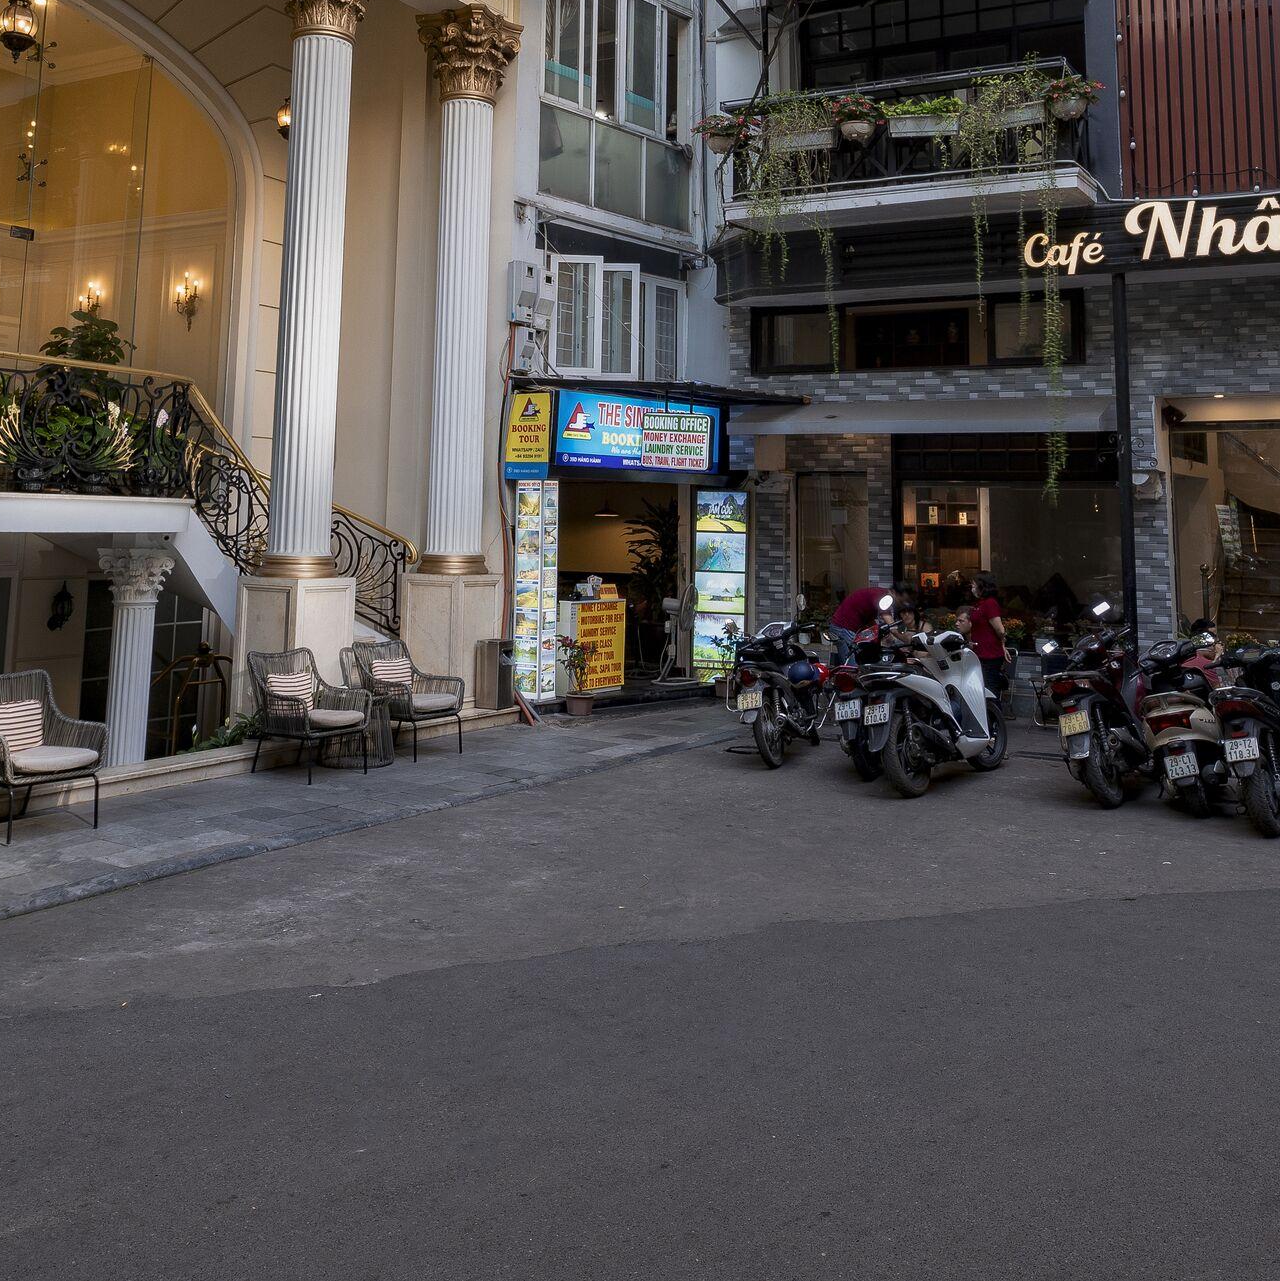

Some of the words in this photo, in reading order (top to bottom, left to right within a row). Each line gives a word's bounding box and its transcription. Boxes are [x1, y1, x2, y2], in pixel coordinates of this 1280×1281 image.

[1023, 231, 1106, 276] Café
[598, 402, 622, 427] THE
[624, 404, 654, 429] SIN
[511, 424, 547, 433] BOOKING
[643, 415, 679, 431] BOOKING
[680, 417, 708, 432] OFFICE
[519, 435, 539, 443] TOUR
[602, 431, 642, 447] BOOKI
[644, 432, 669, 442] MONEY
[669, 433, 706, 444] EXCHANGE
[644, 443, 674, 454] LAUNDRY
[675, 444, 703, 456] SERVICE
[623, 458, 642, 467] WHATS
[671, 457, 688, 467] FLIGHT
[689, 458, 705, 468] TICKET
[596, 602, 618, 611] EXCHANGE
[580, 615, 605, 626] MOTORBIKE
[614, 613, 624, 623] RENT
[580, 628, 598, 638] LAUNDRY
[599, 626, 617, 636] SERVICE
[599, 639, 613, 649] CLASS
[599, 663, 611, 673] SAPA
[595, 674, 622, 686] EVERYWHERE
[1229, 740, 1253, 750] 29-T2
[1228, 749, 1257, 760] 118.34
[1169, 757, 1192, 768] 29-C1
[1169, 766, 1197, 779] 243.13
